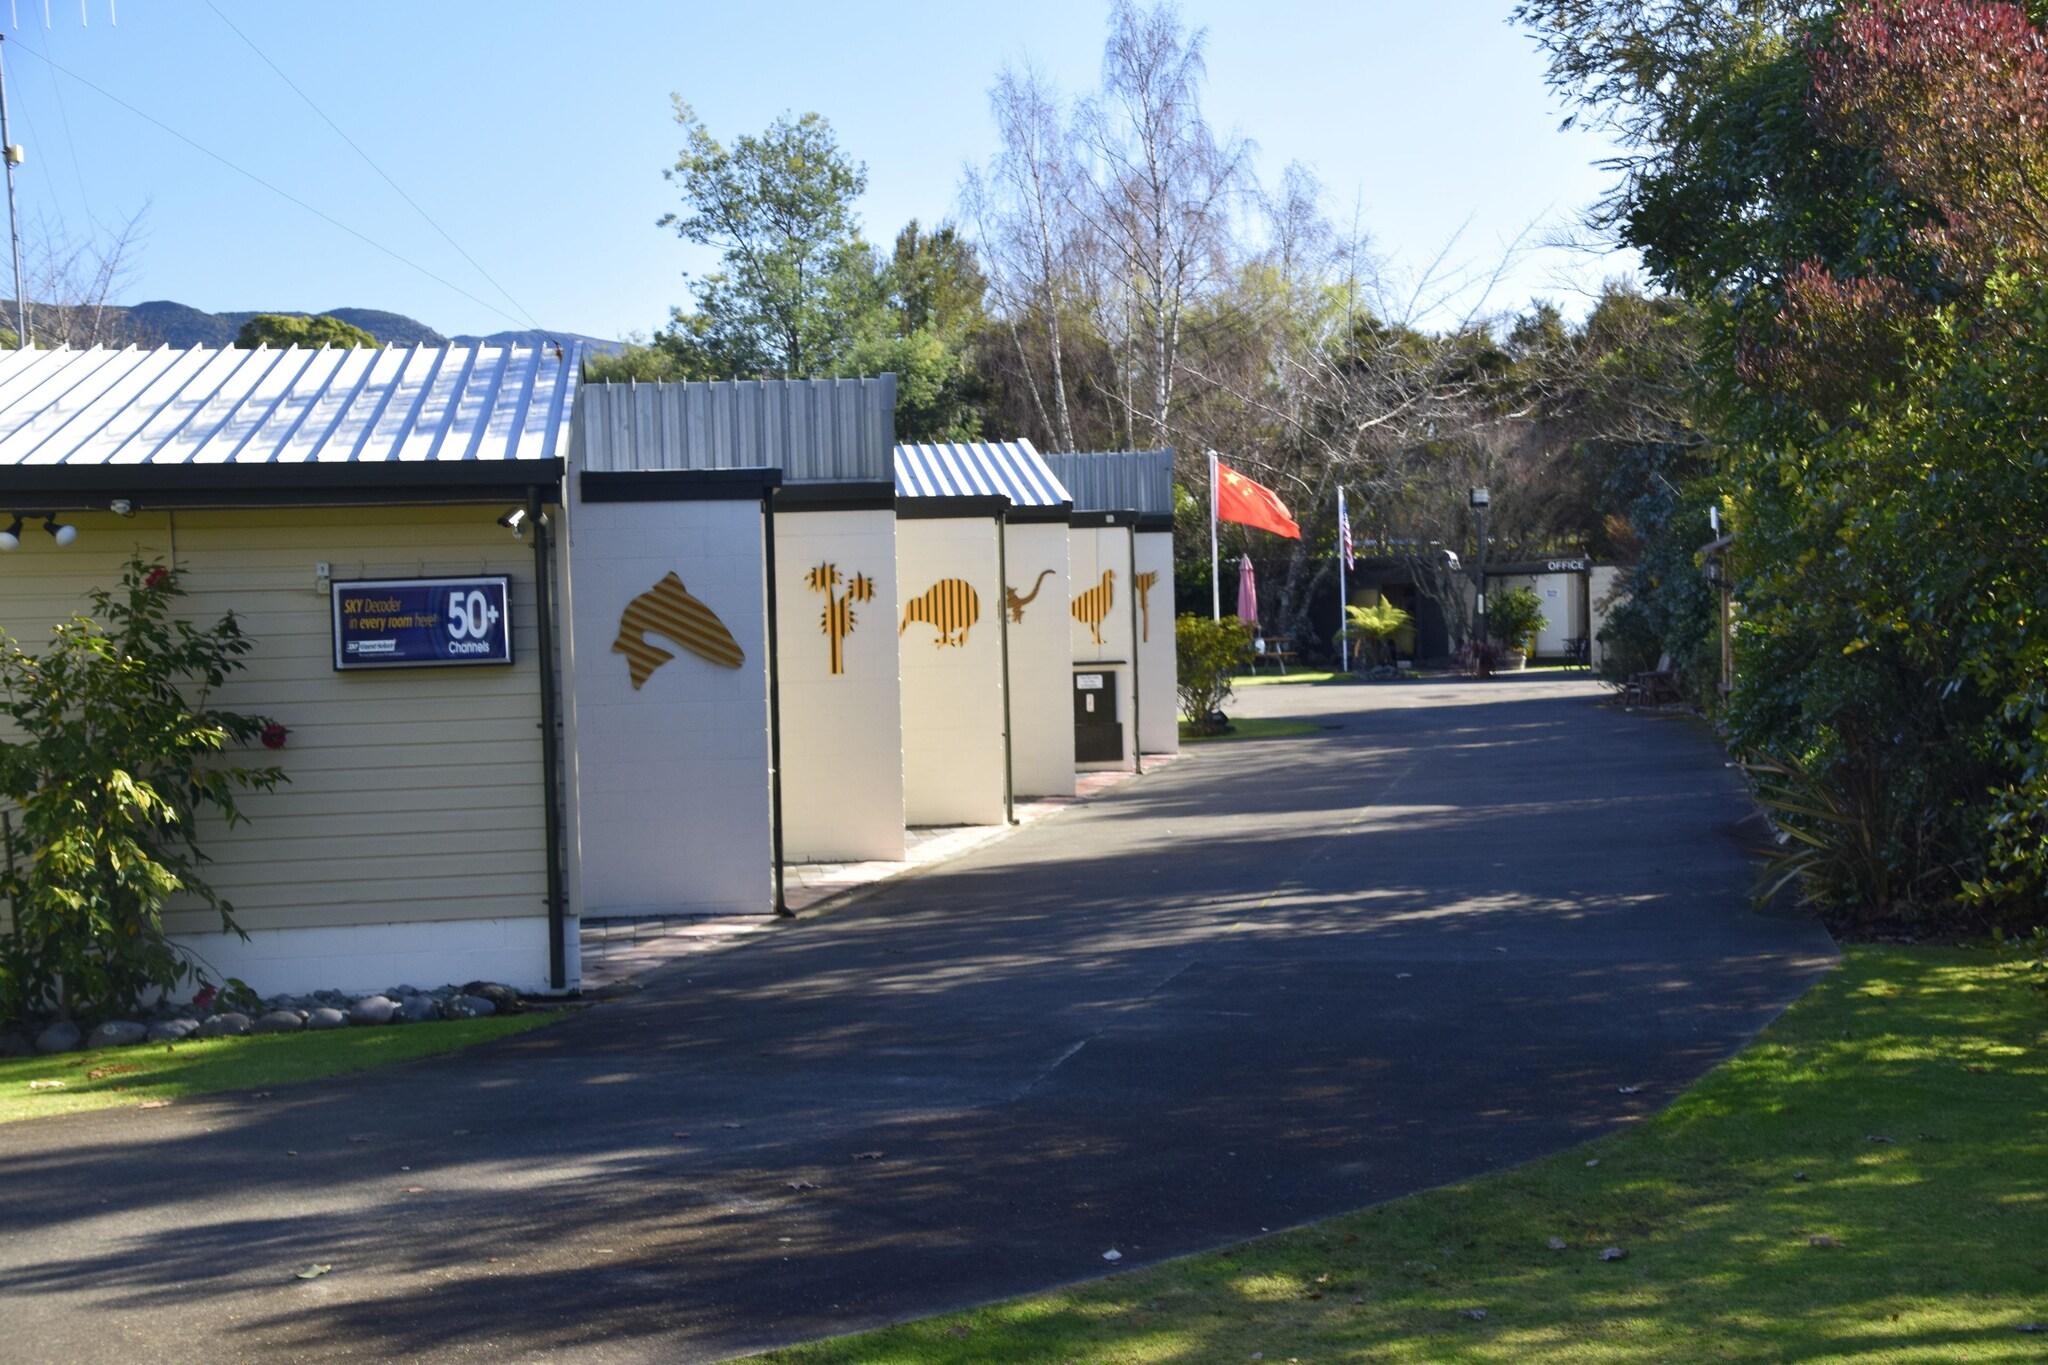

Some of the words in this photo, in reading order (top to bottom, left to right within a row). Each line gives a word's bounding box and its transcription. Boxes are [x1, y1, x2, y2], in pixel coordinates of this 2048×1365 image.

[1548, 560, 1584, 570] OFFICE
[344, 599, 363, 613] SKY
[365, 596, 402, 613] Decoder
[448, 590, 499, 639] 50+
[349, 618, 358, 629] in
[360, 617, 386, 632] every
[388, 615, 412, 629] room
[448, 641, 489, 654] Channels
